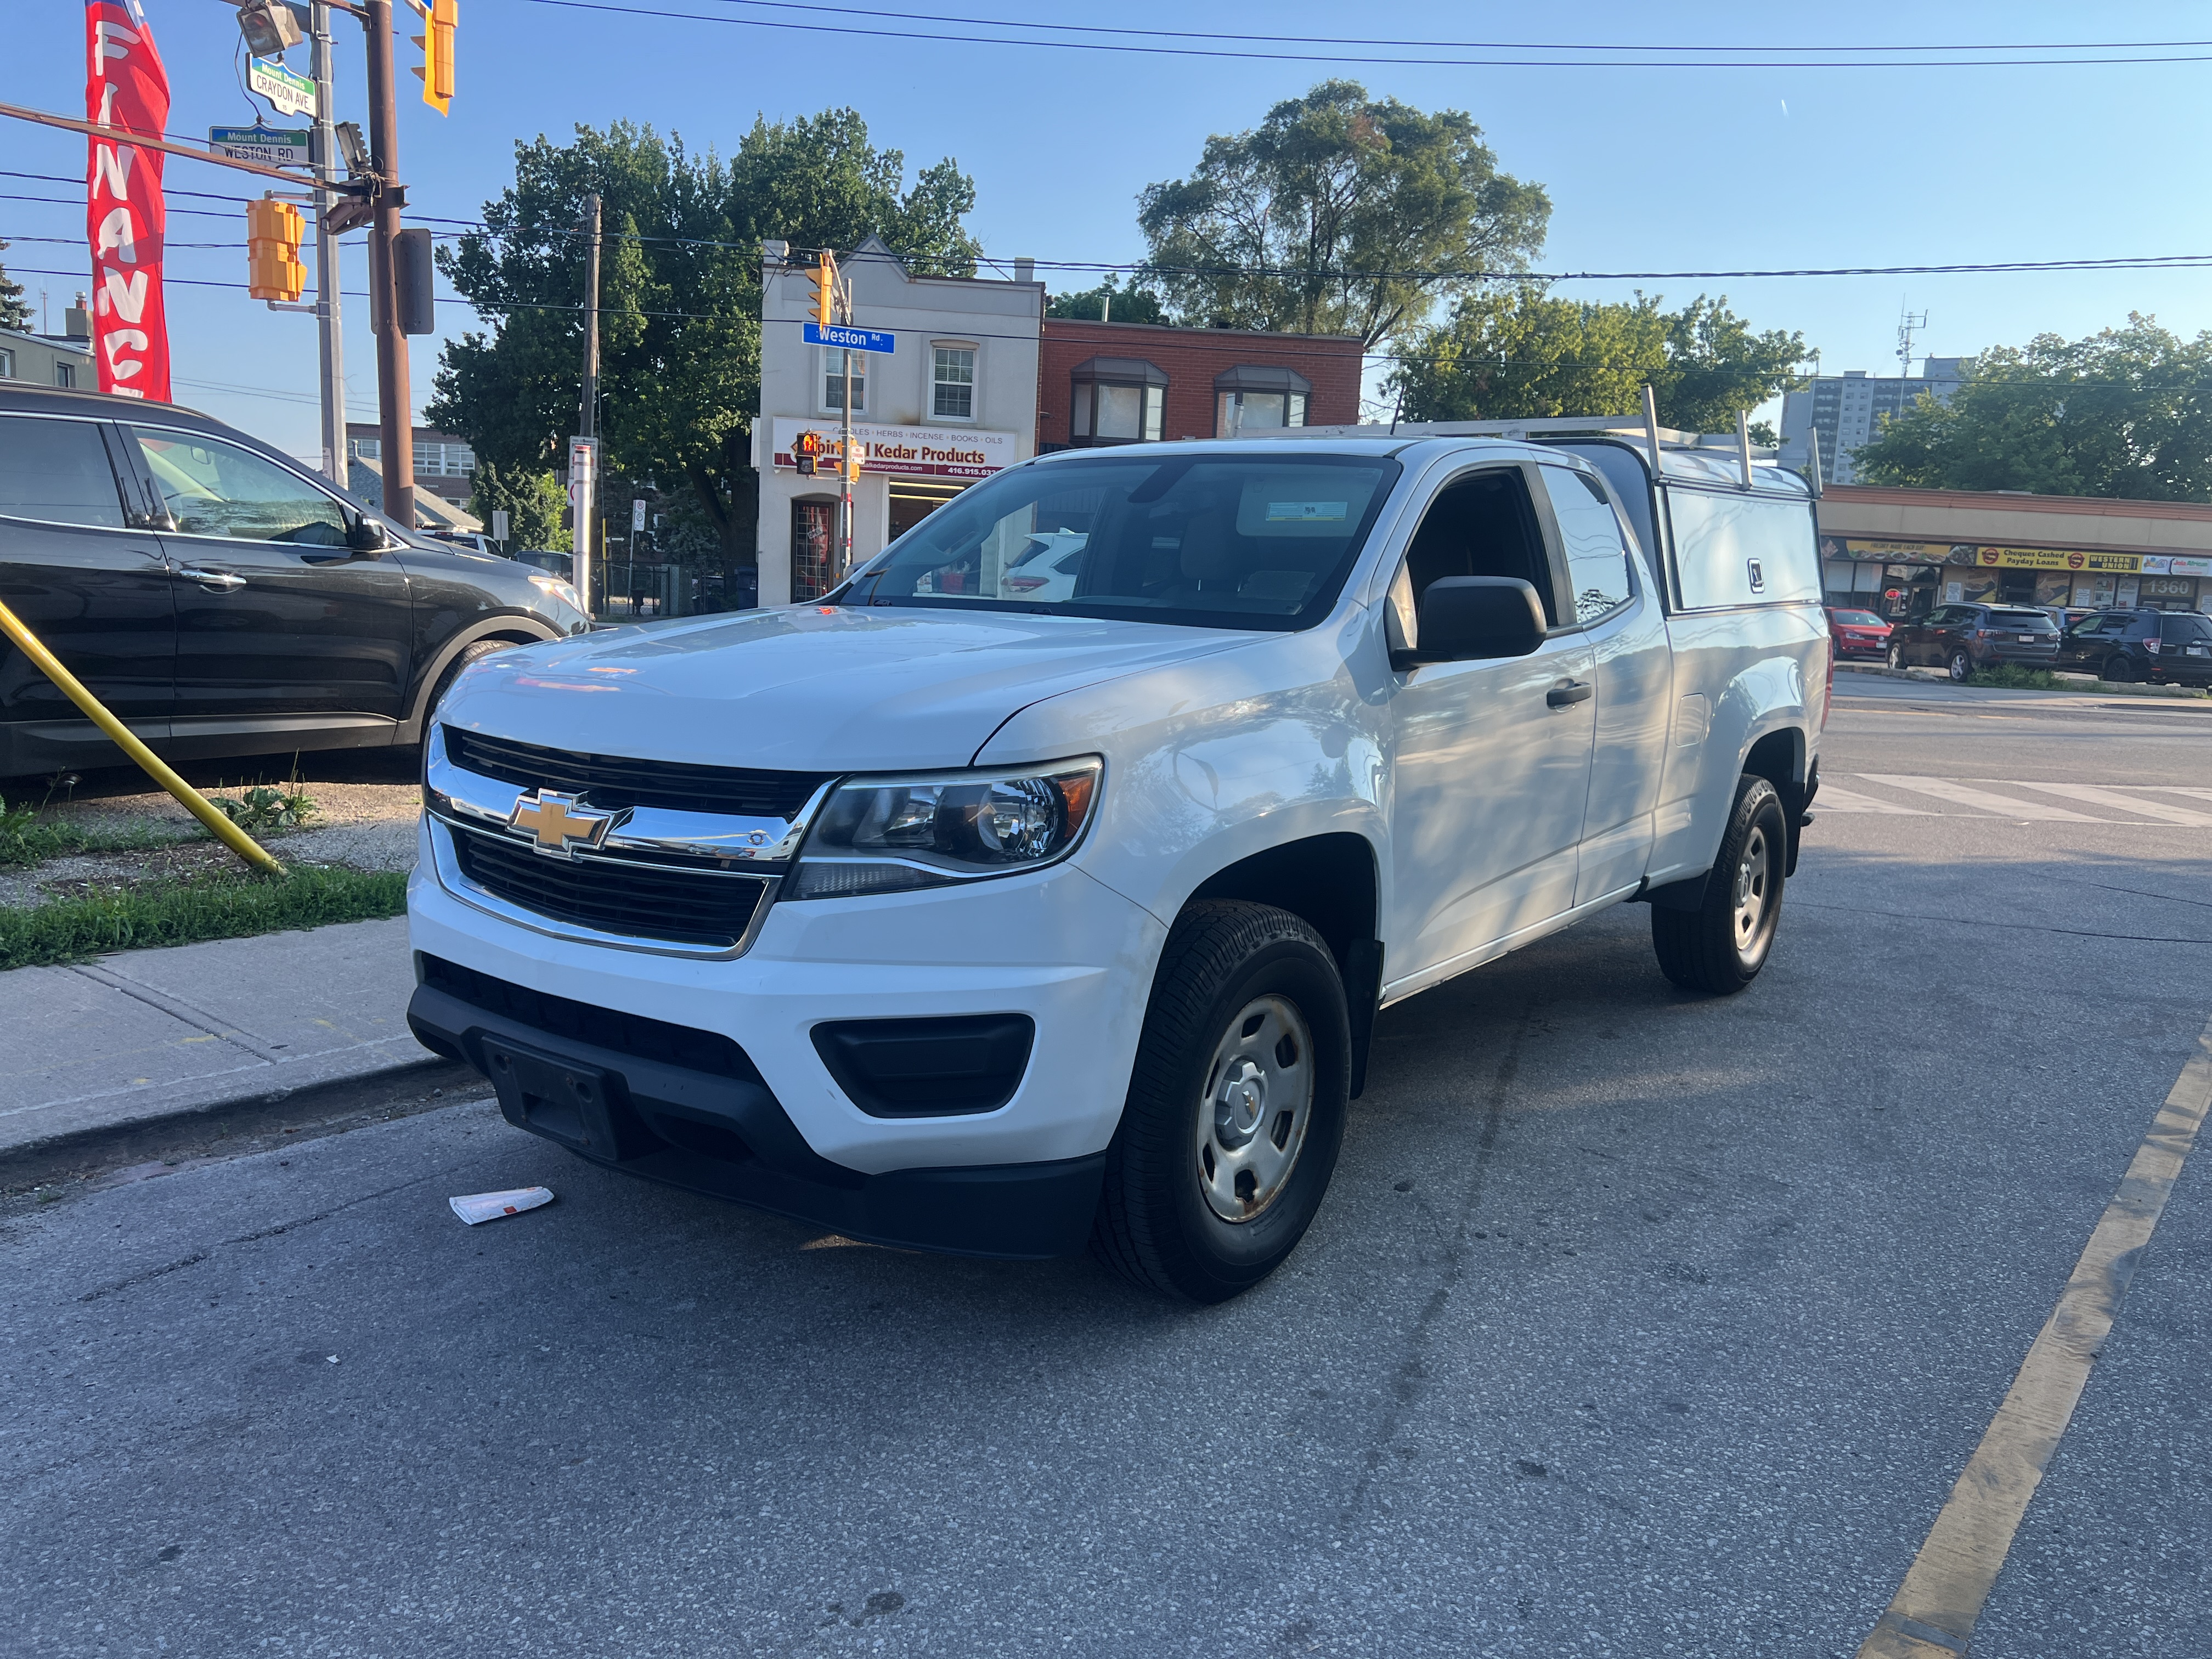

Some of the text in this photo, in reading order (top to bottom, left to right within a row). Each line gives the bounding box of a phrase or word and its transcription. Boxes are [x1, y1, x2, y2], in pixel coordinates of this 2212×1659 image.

[262, 63, 305, 90] Mount Dennis
[257, 75, 293, 104] CRAYDON
[228, 132, 291, 144] Mount Dennis
[224, 145, 272, 161] WESTON
[93, 21, 149, 398] FINANC
[819, 327, 866, 346] Weston
[877, 430, 903, 438] HERBS
[910, 432, 944, 441] INCENSE
[874, 443, 918, 460] Kedar
[922, 447, 985, 464] Products
[2004, 549, 2035, 557] Cheques
[2007, 557, 2034, 566] Payday
[2149, 579, 2190, 594] 1360
